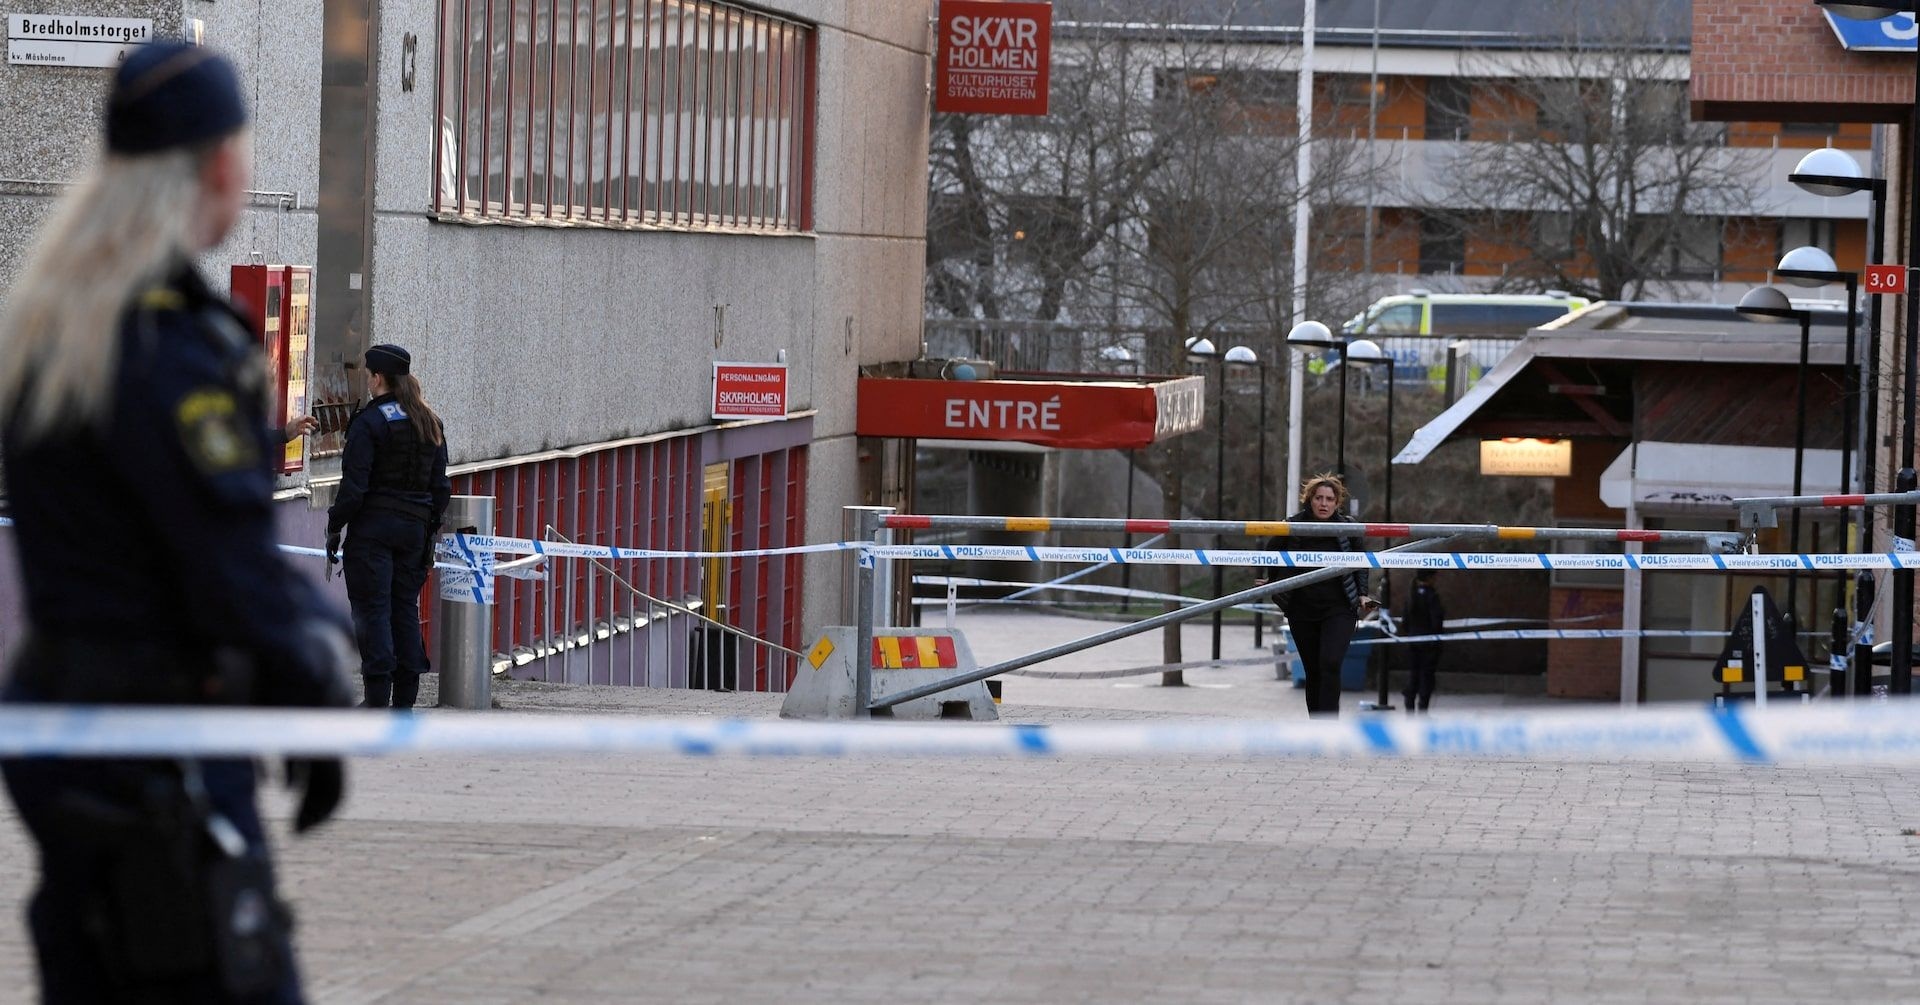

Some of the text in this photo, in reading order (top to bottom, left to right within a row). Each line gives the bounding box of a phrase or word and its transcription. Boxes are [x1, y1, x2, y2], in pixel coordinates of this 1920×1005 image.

[22, 19, 147, 41] Bredholmstorget
[949, 15, 1038, 48] SKÄR
[11, 52, 23, 60] kv.
[948, 46, 1038, 69] HOLMEN
[948, 73, 1037, 88] KULTURHUSET
[948, 86, 1036, 99] STADSTEATERN
[1869, 272, 1897, 287] 3,0
[720, 372, 781, 383] PERSONALINGÅNG
[719, 391, 781, 404] SKÄRHOLMEN
[945, 395, 1061, 431] ENTRÉ
[469, 536, 495, 547] POLIS
[912, 549, 940, 558] POLIS
[956, 547, 983, 556] POLIS
[1082, 552, 1109, 561] POLIS
[1125, 550, 1152, 560] POLIS
[1251, 556, 1279, 565] POLIS
[1296, 553, 1323, 562] POLIS
[1422, 558, 1450, 567] POLIS
[1467, 555, 1494, 564] POLIS
[1640, 556, 1668, 565] POLIS
[1815, 556, 1843, 565] POLIS
[1595, 558, 1623, 568] POLIS
[1770, 558, 1797, 568] POLIS
